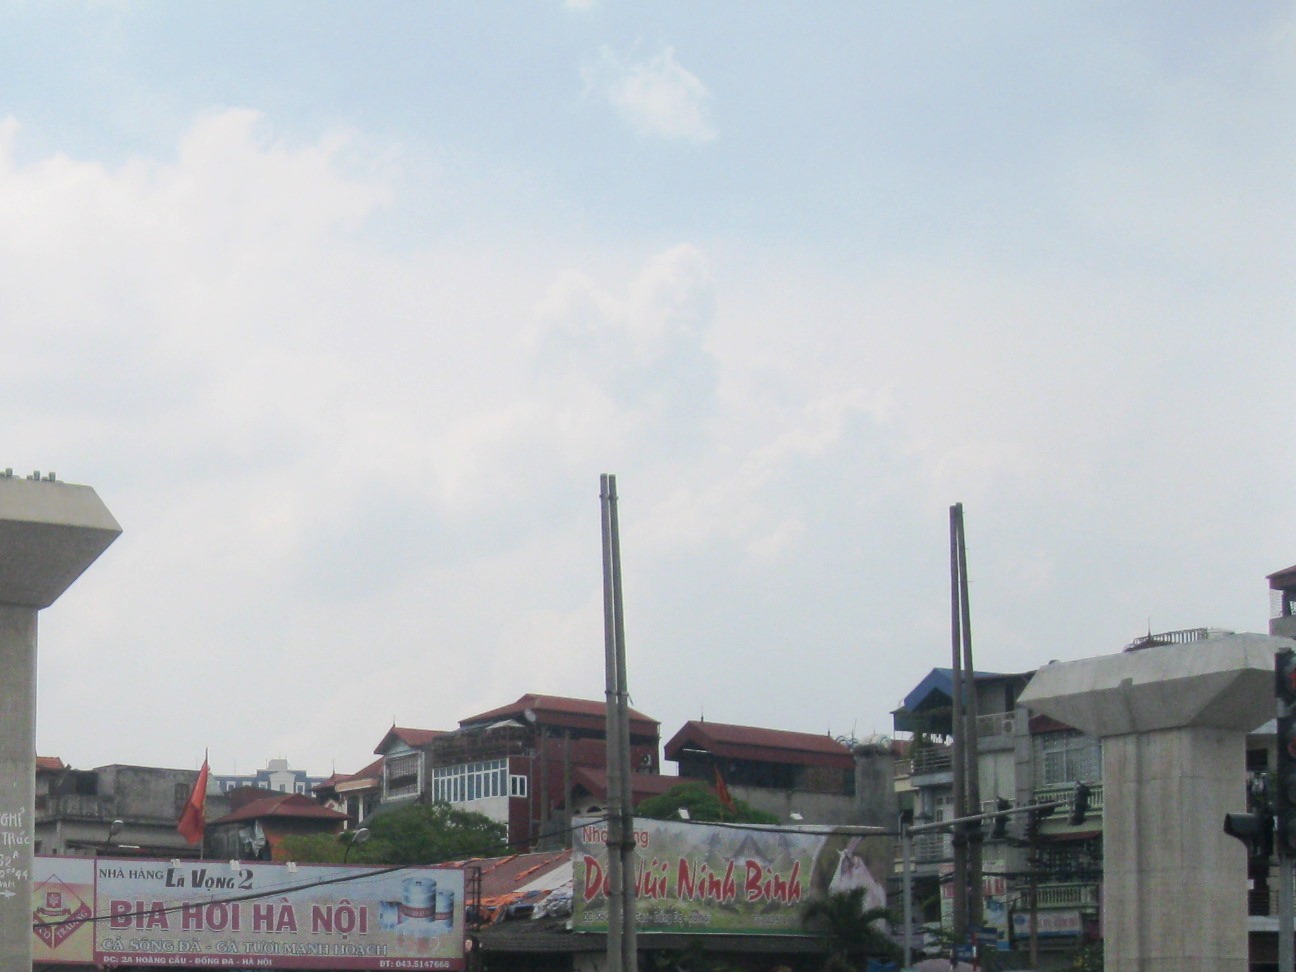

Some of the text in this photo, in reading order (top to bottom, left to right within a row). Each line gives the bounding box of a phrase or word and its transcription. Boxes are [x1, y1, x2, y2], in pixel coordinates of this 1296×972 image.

[99, 866, 124, 879] NHÀ
[129, 867, 164, 880] HÀNG
[238, 868, 254, 890] 2
[677, 858, 736, 904] Ninh
[110, 900, 169, 931] BIA
[253, 897, 298, 934] HÀ
[312, 898, 368, 939] NỘI
[129, 936, 174, 952] SÔNG
